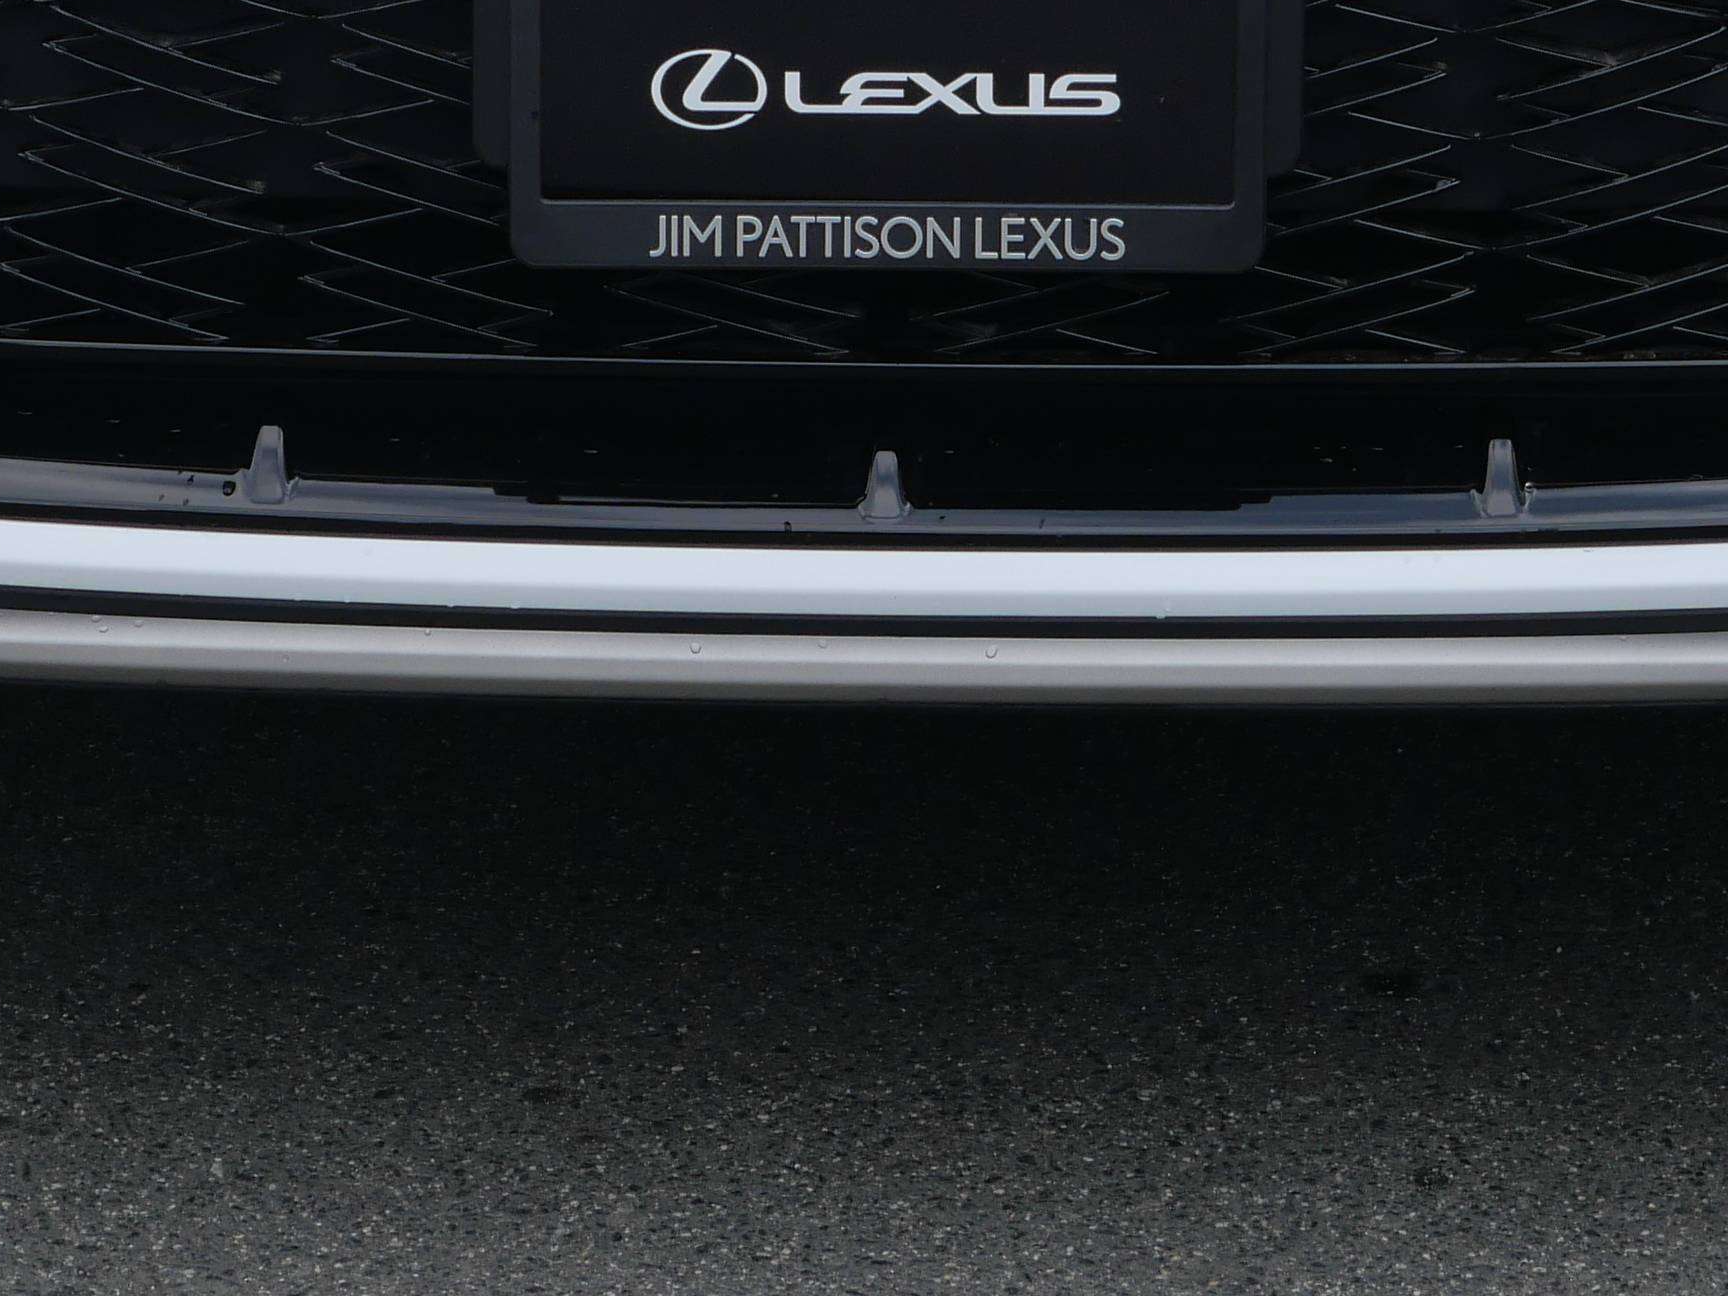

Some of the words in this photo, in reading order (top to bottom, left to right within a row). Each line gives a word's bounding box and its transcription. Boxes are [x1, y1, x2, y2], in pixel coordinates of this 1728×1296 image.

[784, 71, 1121, 116] LEXUS
[649, 214, 723, 258] JIM
[736, 214, 962, 259] PATTISON
[974, 216, 1127, 261] LEXUS
